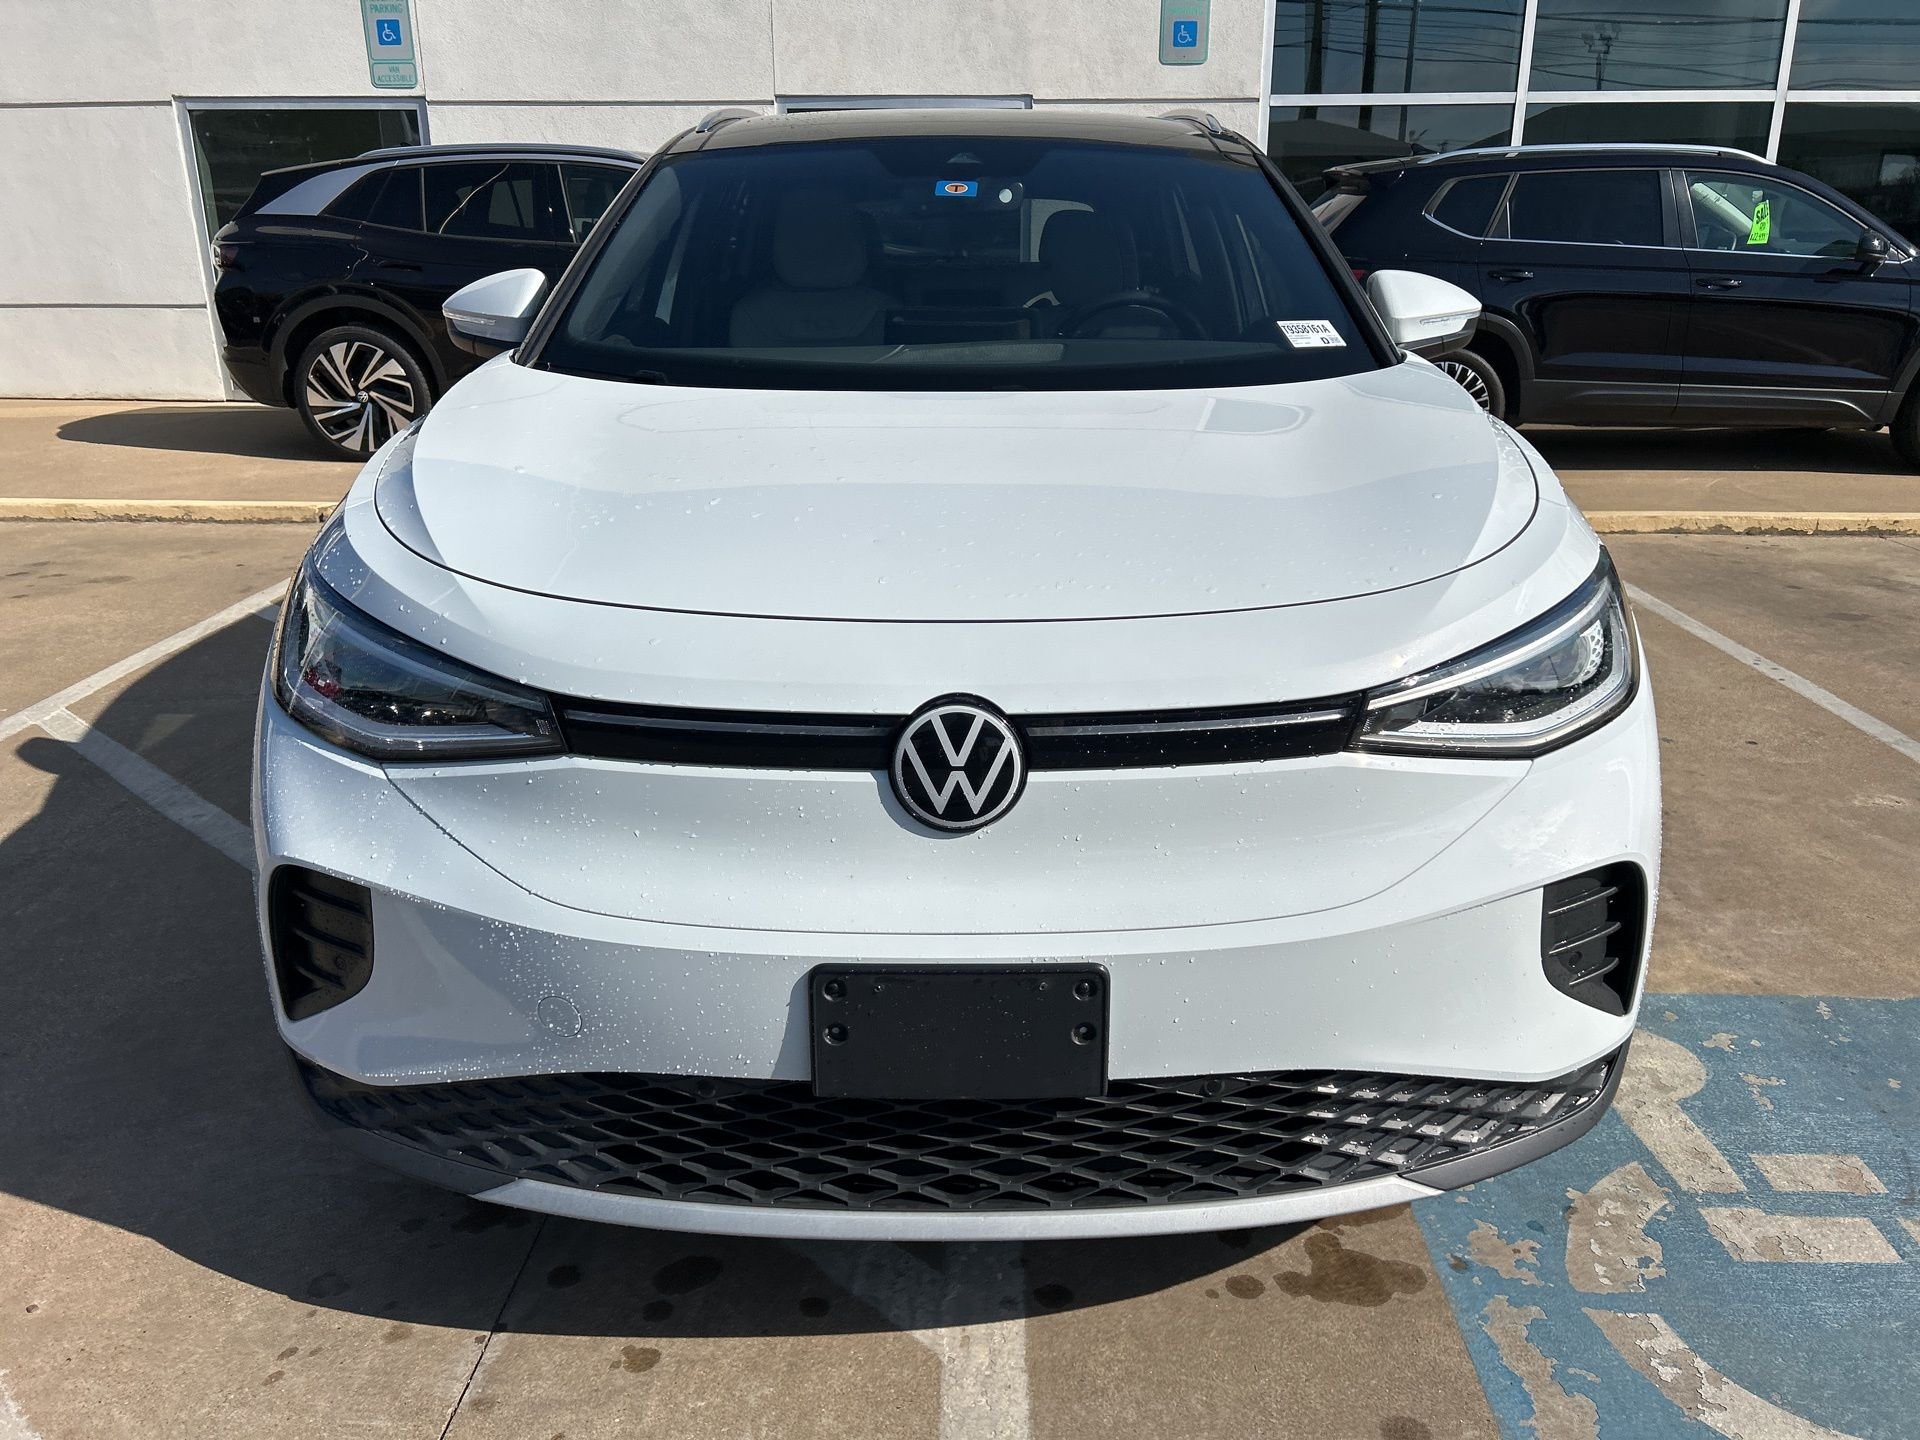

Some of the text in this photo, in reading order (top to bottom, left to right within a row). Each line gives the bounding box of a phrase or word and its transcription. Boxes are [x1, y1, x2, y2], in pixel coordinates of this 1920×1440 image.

[370, 4, 403, 13] PARKING
[389, 65, 400, 73] VAN
[377, 74, 413, 83] ACCESSIBLE
[1281, 324, 1331, 334] T9358161A
[901, 710, 1015, 817] VW
